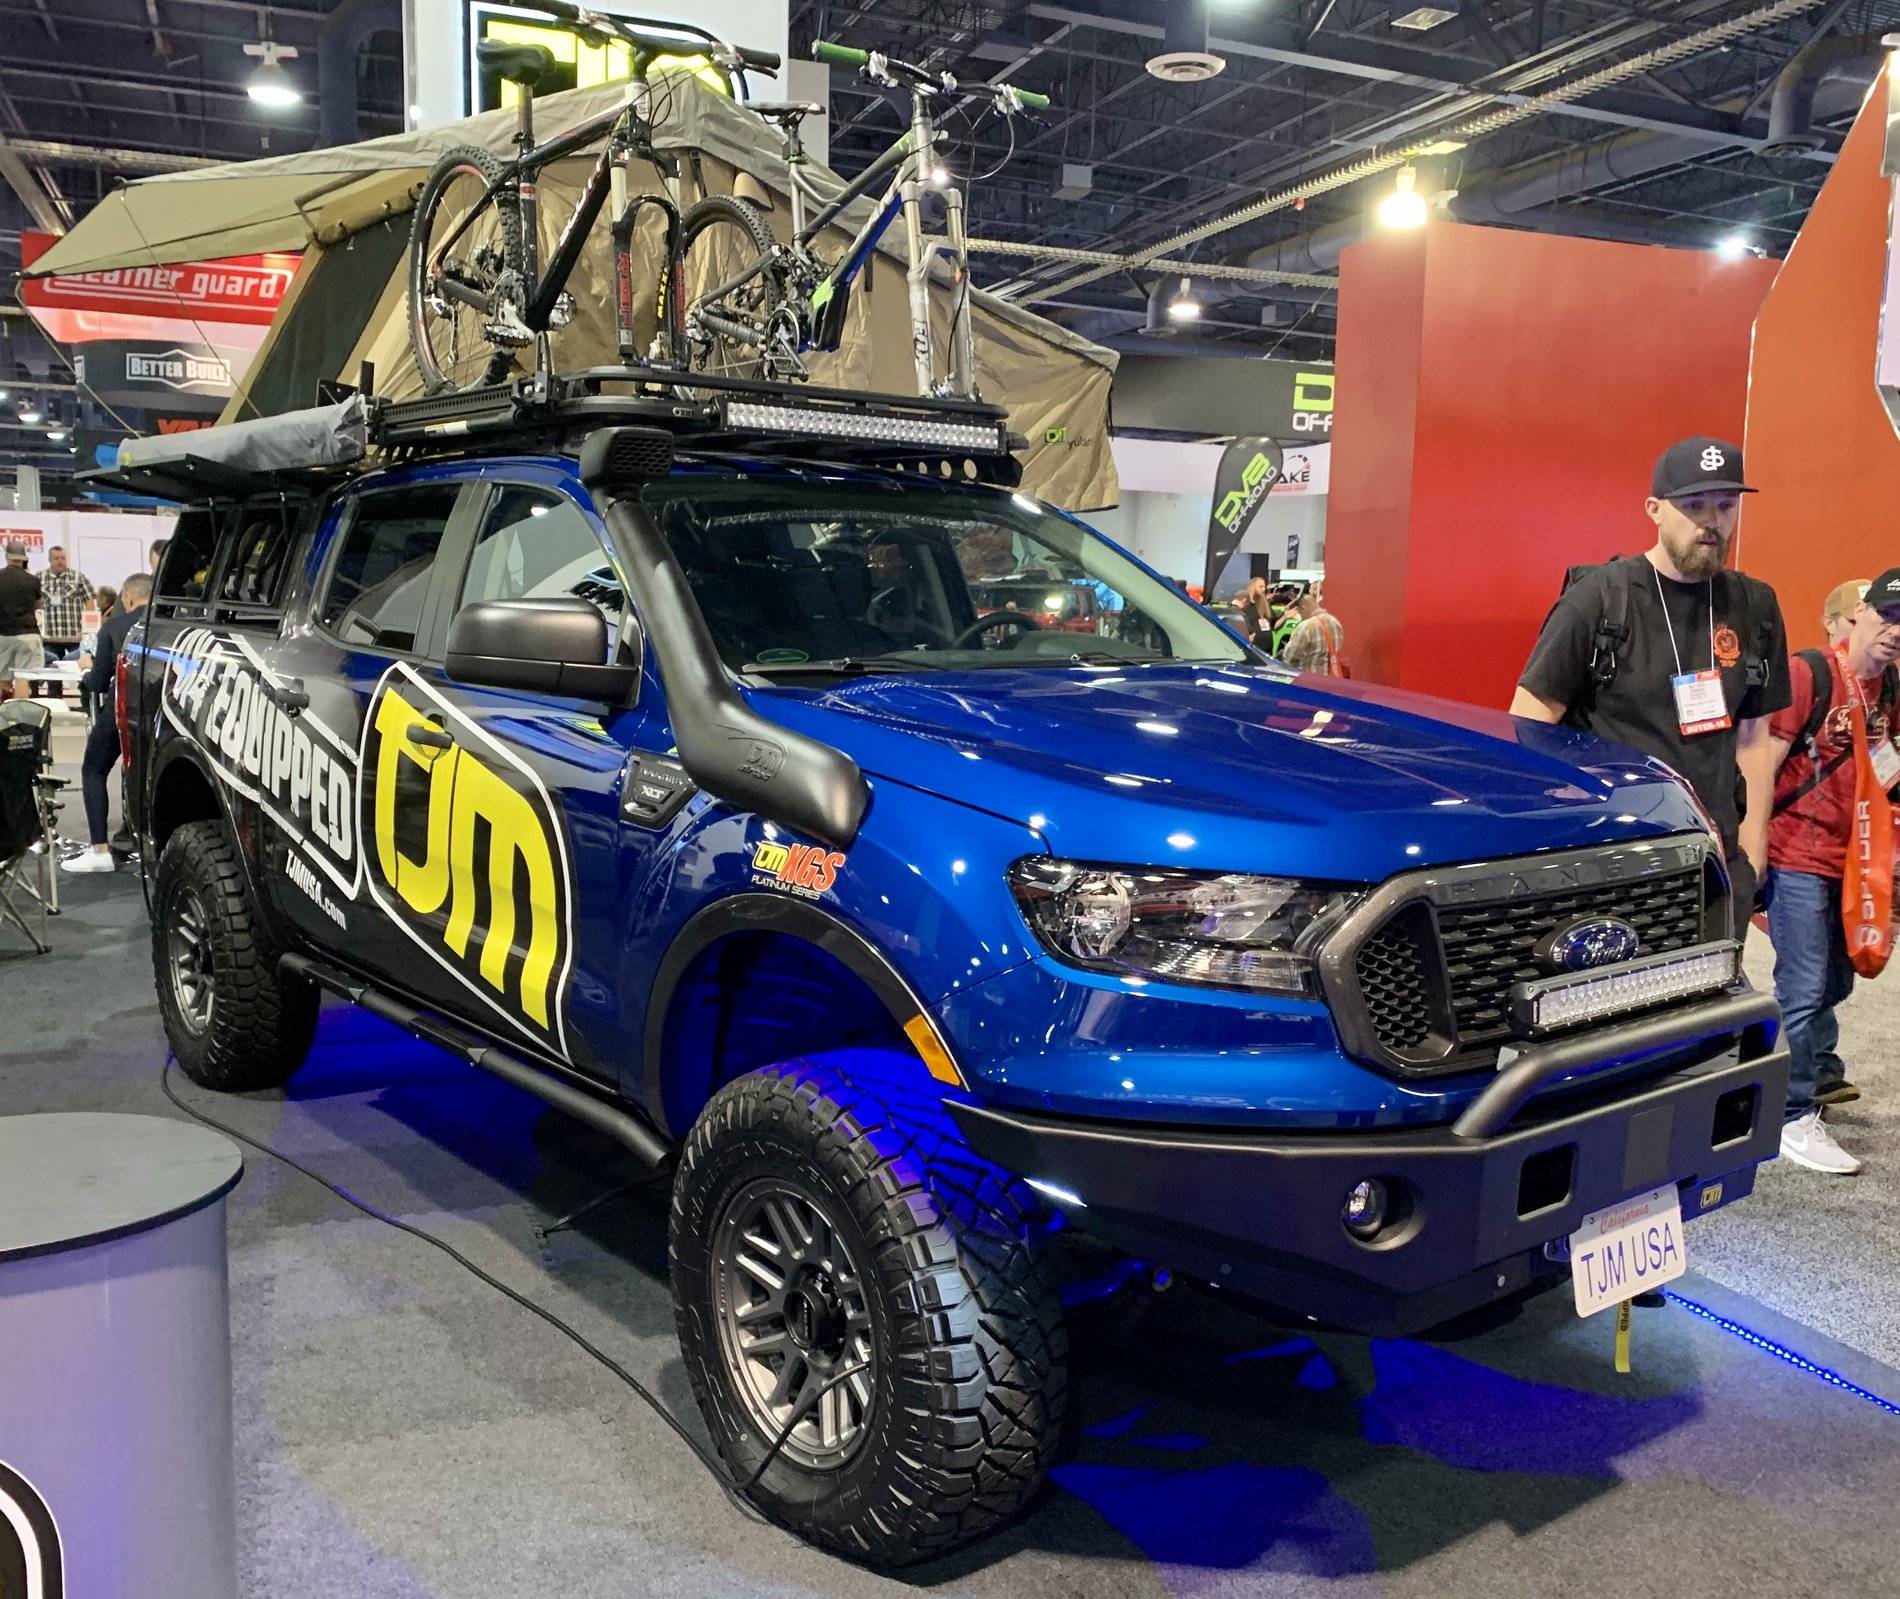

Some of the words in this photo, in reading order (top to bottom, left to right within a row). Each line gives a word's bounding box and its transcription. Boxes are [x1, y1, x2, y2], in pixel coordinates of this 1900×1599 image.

[57, 267, 184, 290] eather
[192, 272, 277, 299] guard
[130, 357, 183, 378] BETTER
[185, 360, 225, 381] BUILT
[1214, 453, 1271, 528] DV8
[204, 661, 352, 861] EQUIPPED
[641, 785, 665, 800] XLT
[751, 874, 790, 892] PLATINUM
[791, 885, 821, 900] SERIES
[1582, 931, 1627, 966] Ford
[1600, 1203, 1650, 1234] California
[1581, 1240, 1627, 1298] TJM
[1631, 1222, 1678, 1277] USA
